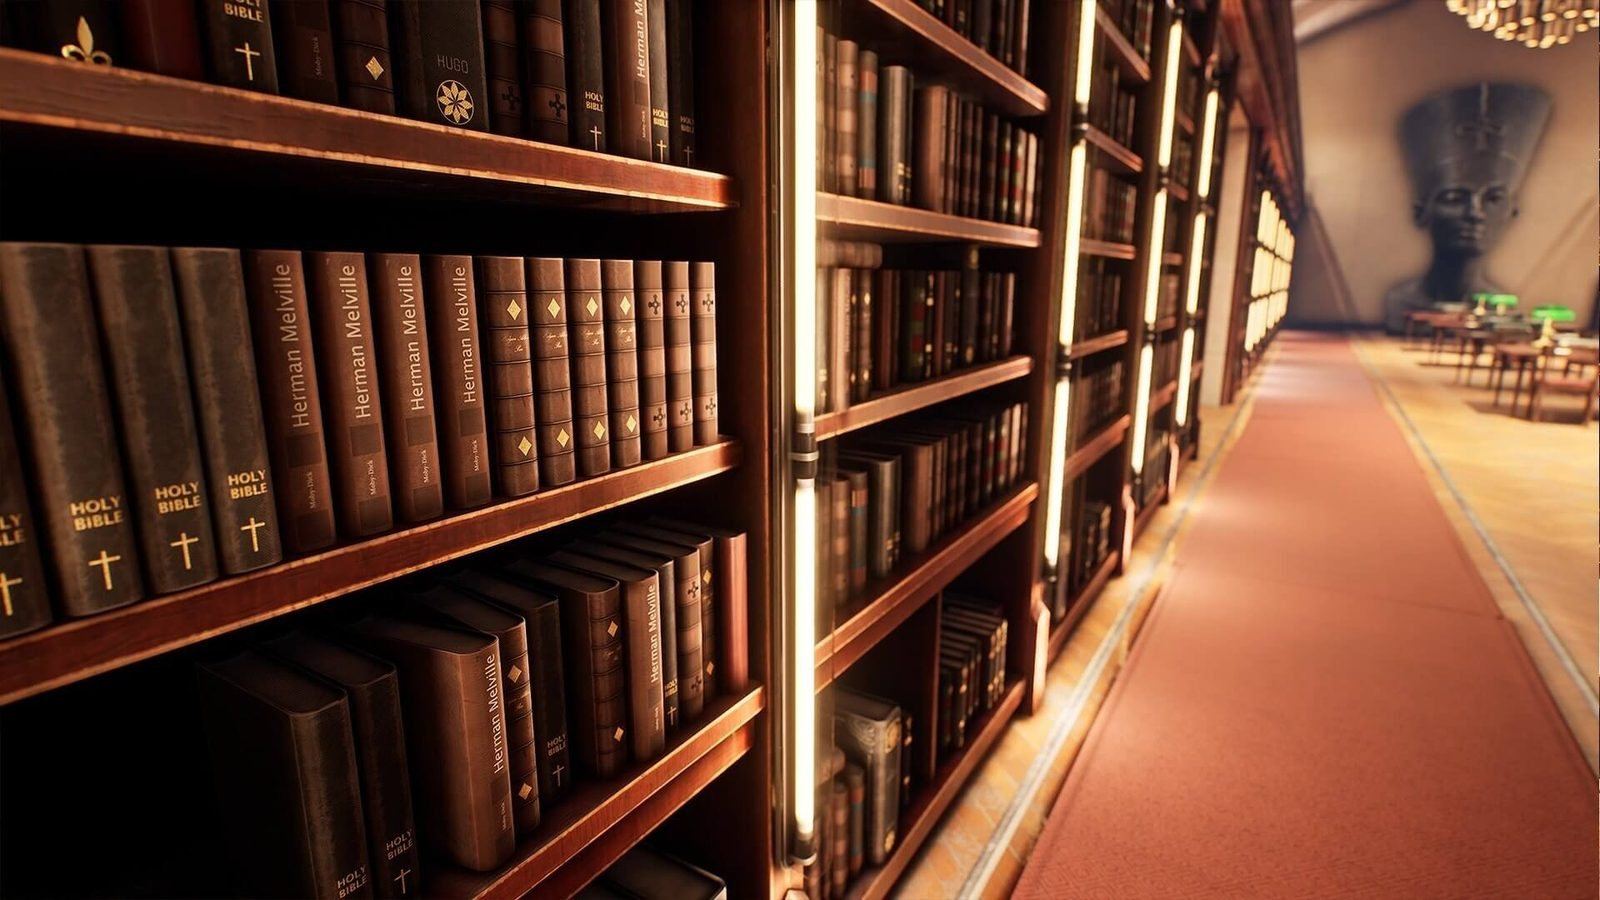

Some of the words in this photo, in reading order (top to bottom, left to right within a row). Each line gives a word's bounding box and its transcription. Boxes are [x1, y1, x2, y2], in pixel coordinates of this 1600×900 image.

[224, 2, 264, 23] BIBLE
[437, 54, 469, 74] HUGO
[636, 20, 646, 78] Herman
[272, 264, 299, 342] Melville
[339, 265, 362, 338] Melville
[397, 266, 418, 335] Melville
[453, 266, 470, 332] Melville
[352, 345, 371, 419] Herman
[405, 342, 425, 411] Herman
[460, 337, 477, 403] Herman
[287, 350, 310, 428] Herman
[154, 481, 200, 500] HOLY
[228, 469, 267, 487] HOLY
[230, 482, 268, 500] BIBLE
[0, 513, 22, 529] LY
[70, 496, 121, 516] HOLY
[74, 511, 123, 531] BIBLE
[157, 495, 201, 515] BIBLE
[647, 584, 657, 633] Melville
[650, 633, 660, 683] Herman
[484, 653, 499, 713] Melville
[490, 713, 504, 774] Herman
[386, 828, 412, 850] HOLY
[387, 838, 413, 860] BIBLE
[337, 865, 366, 889] HOLY
[339, 874, 367, 899] BIBLE
